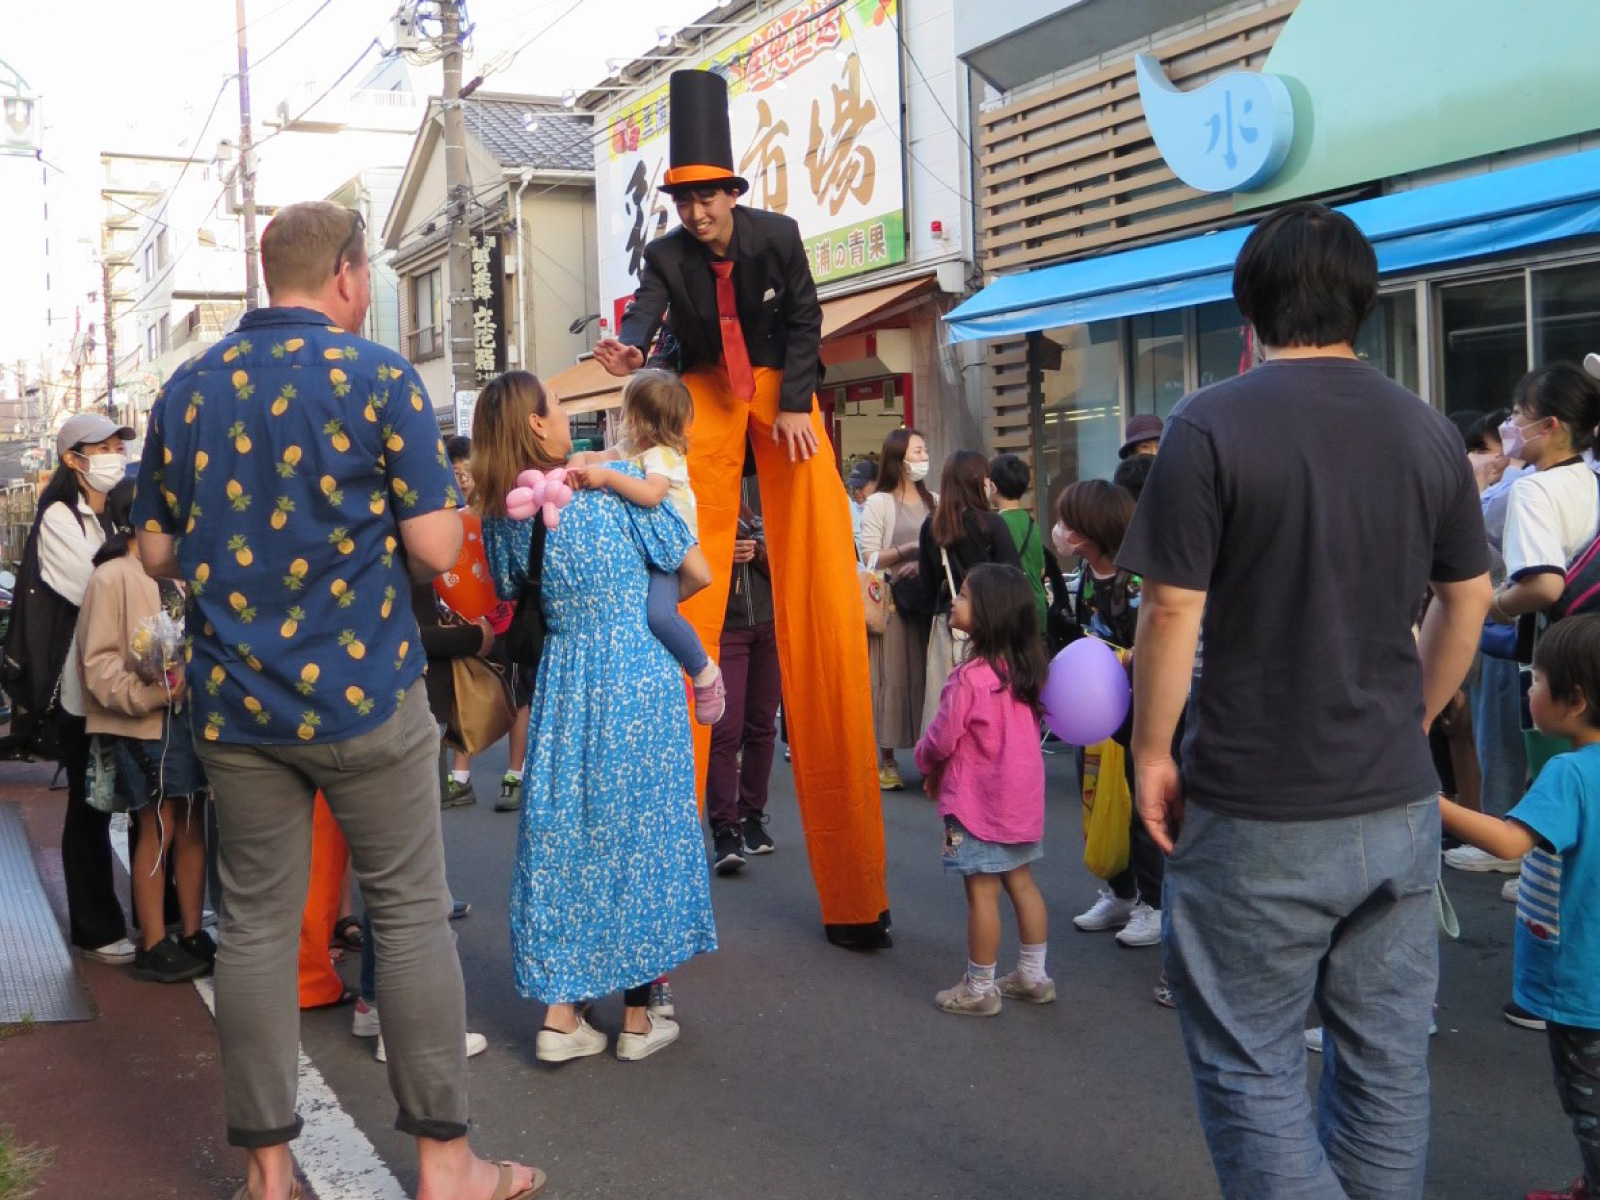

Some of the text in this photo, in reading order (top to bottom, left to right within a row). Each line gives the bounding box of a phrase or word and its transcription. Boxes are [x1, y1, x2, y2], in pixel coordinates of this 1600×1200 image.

[1203, 90, 1258, 170] 水
[804, 222, 886, 277] 浦の青果
